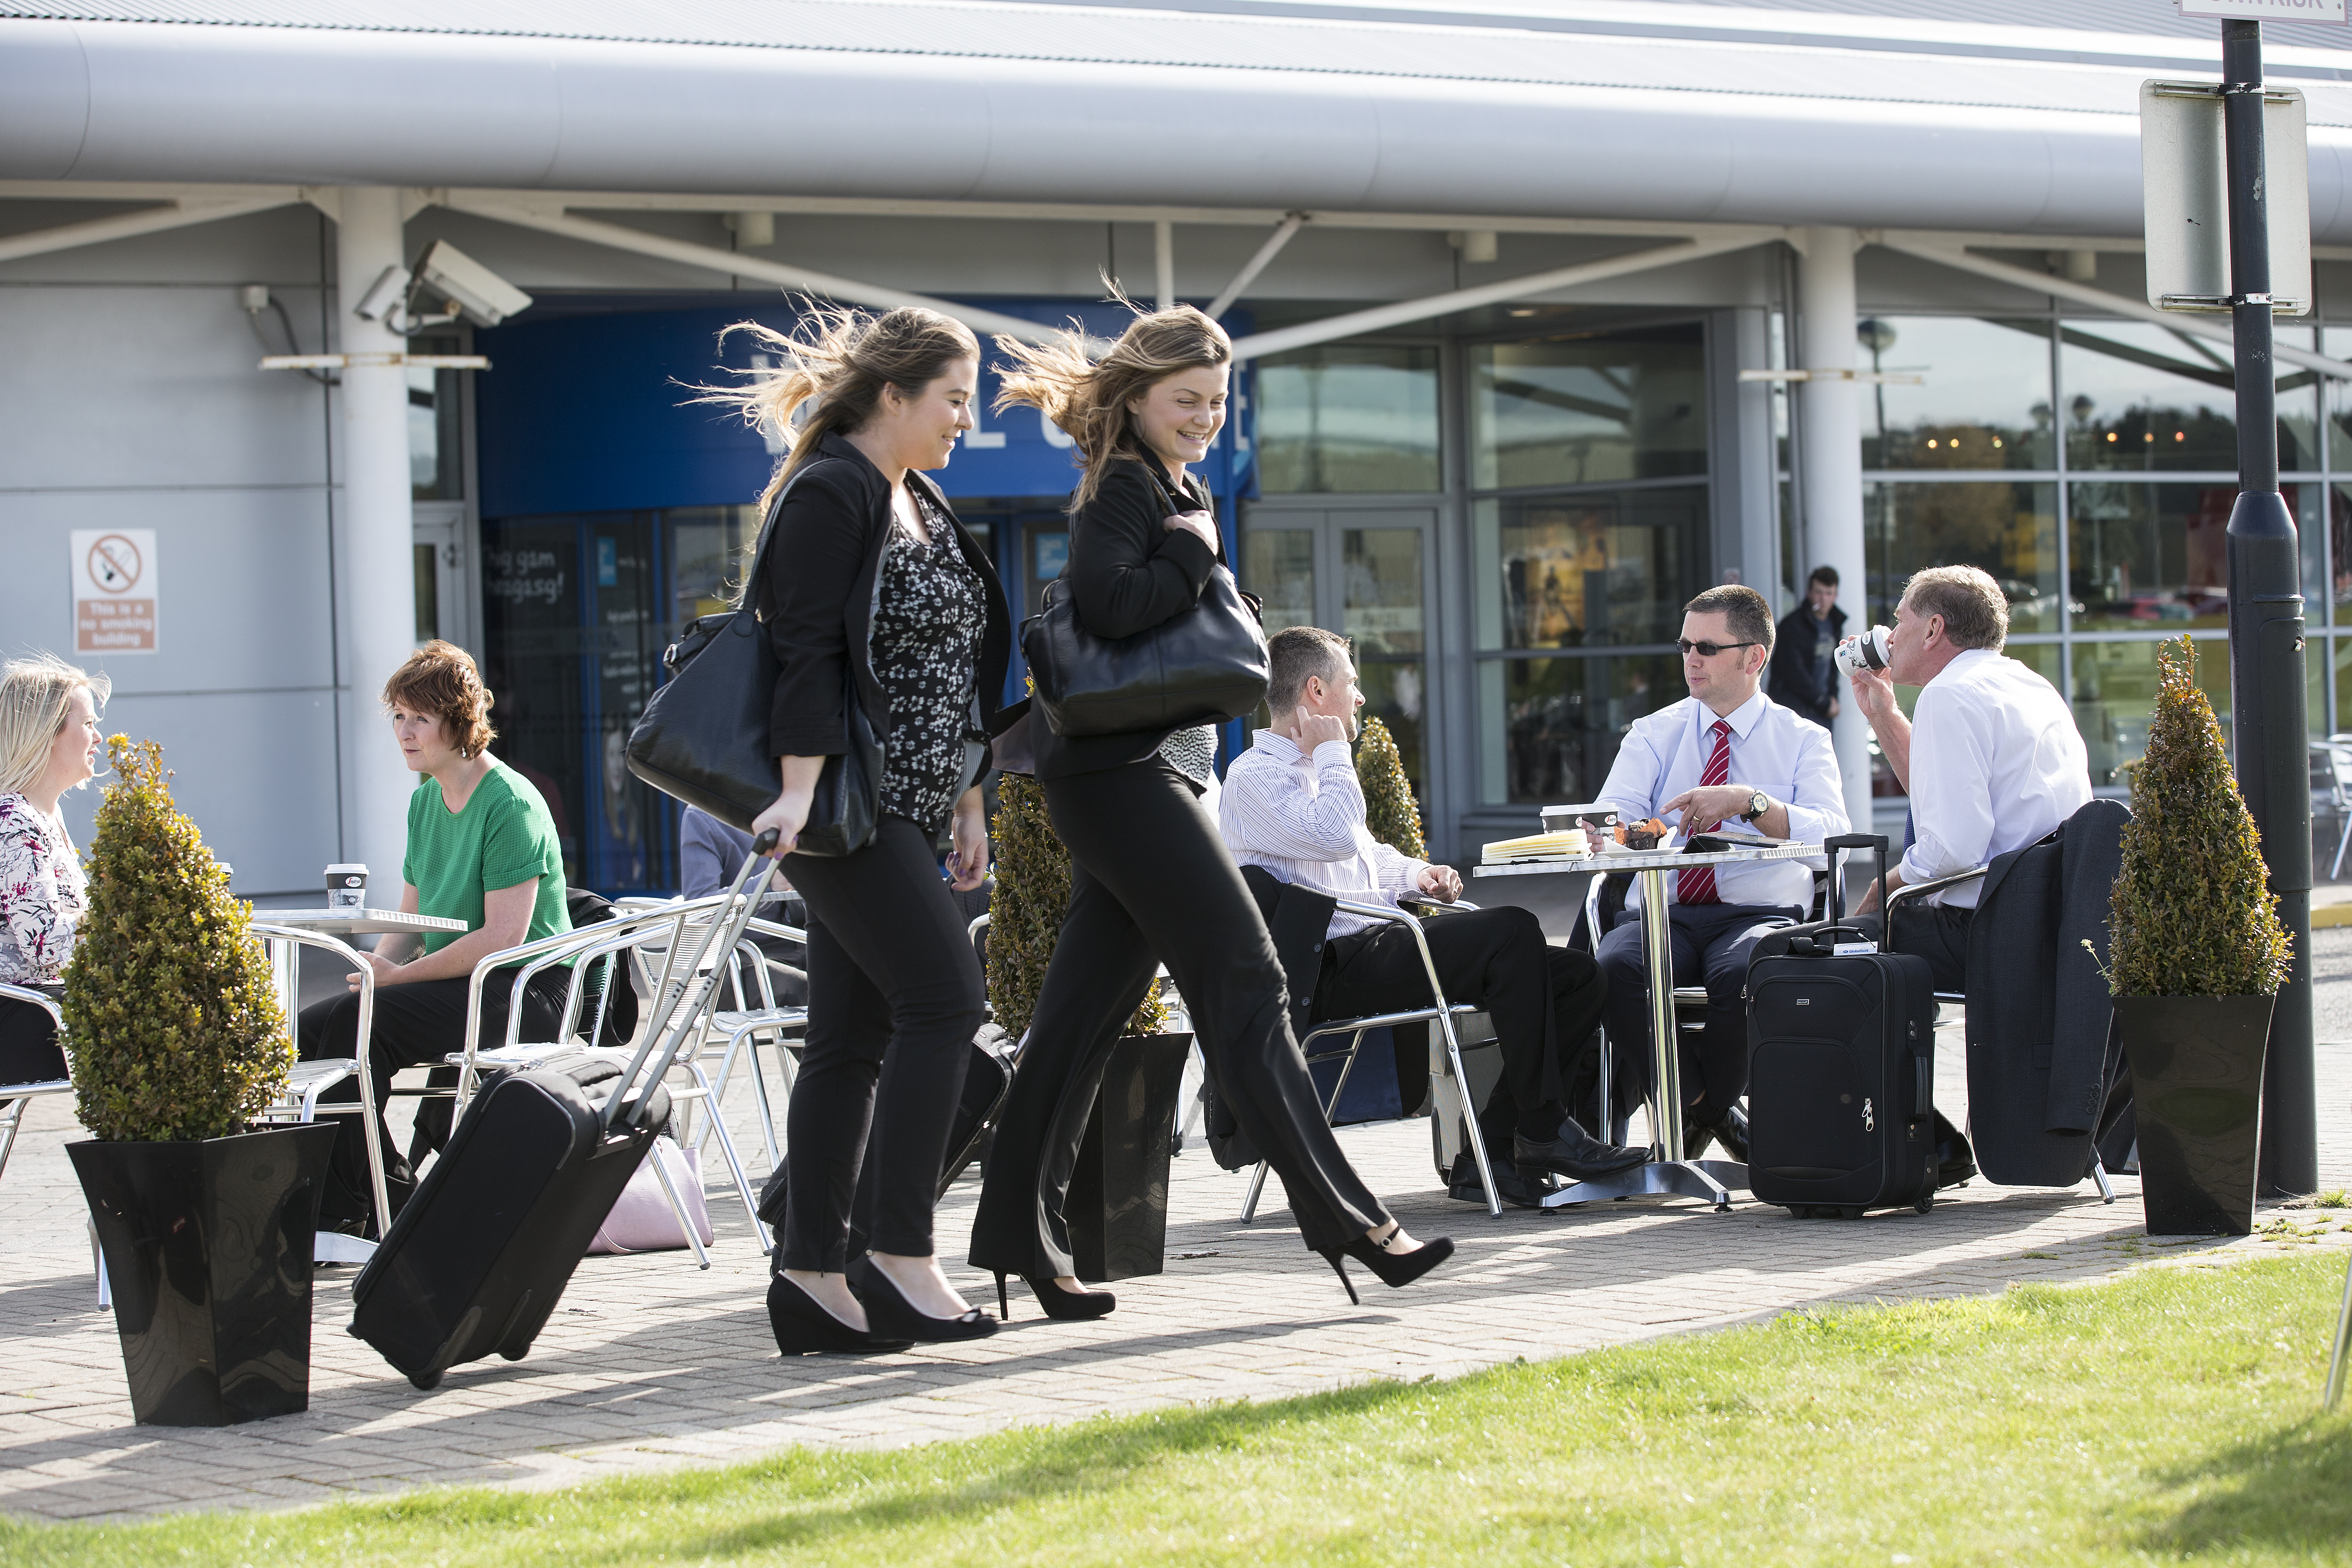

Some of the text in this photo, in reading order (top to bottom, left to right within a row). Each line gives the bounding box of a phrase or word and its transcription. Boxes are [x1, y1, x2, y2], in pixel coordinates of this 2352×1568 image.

[80, 617, 152, 632] no smoking
[92, 632, 141, 647] building
